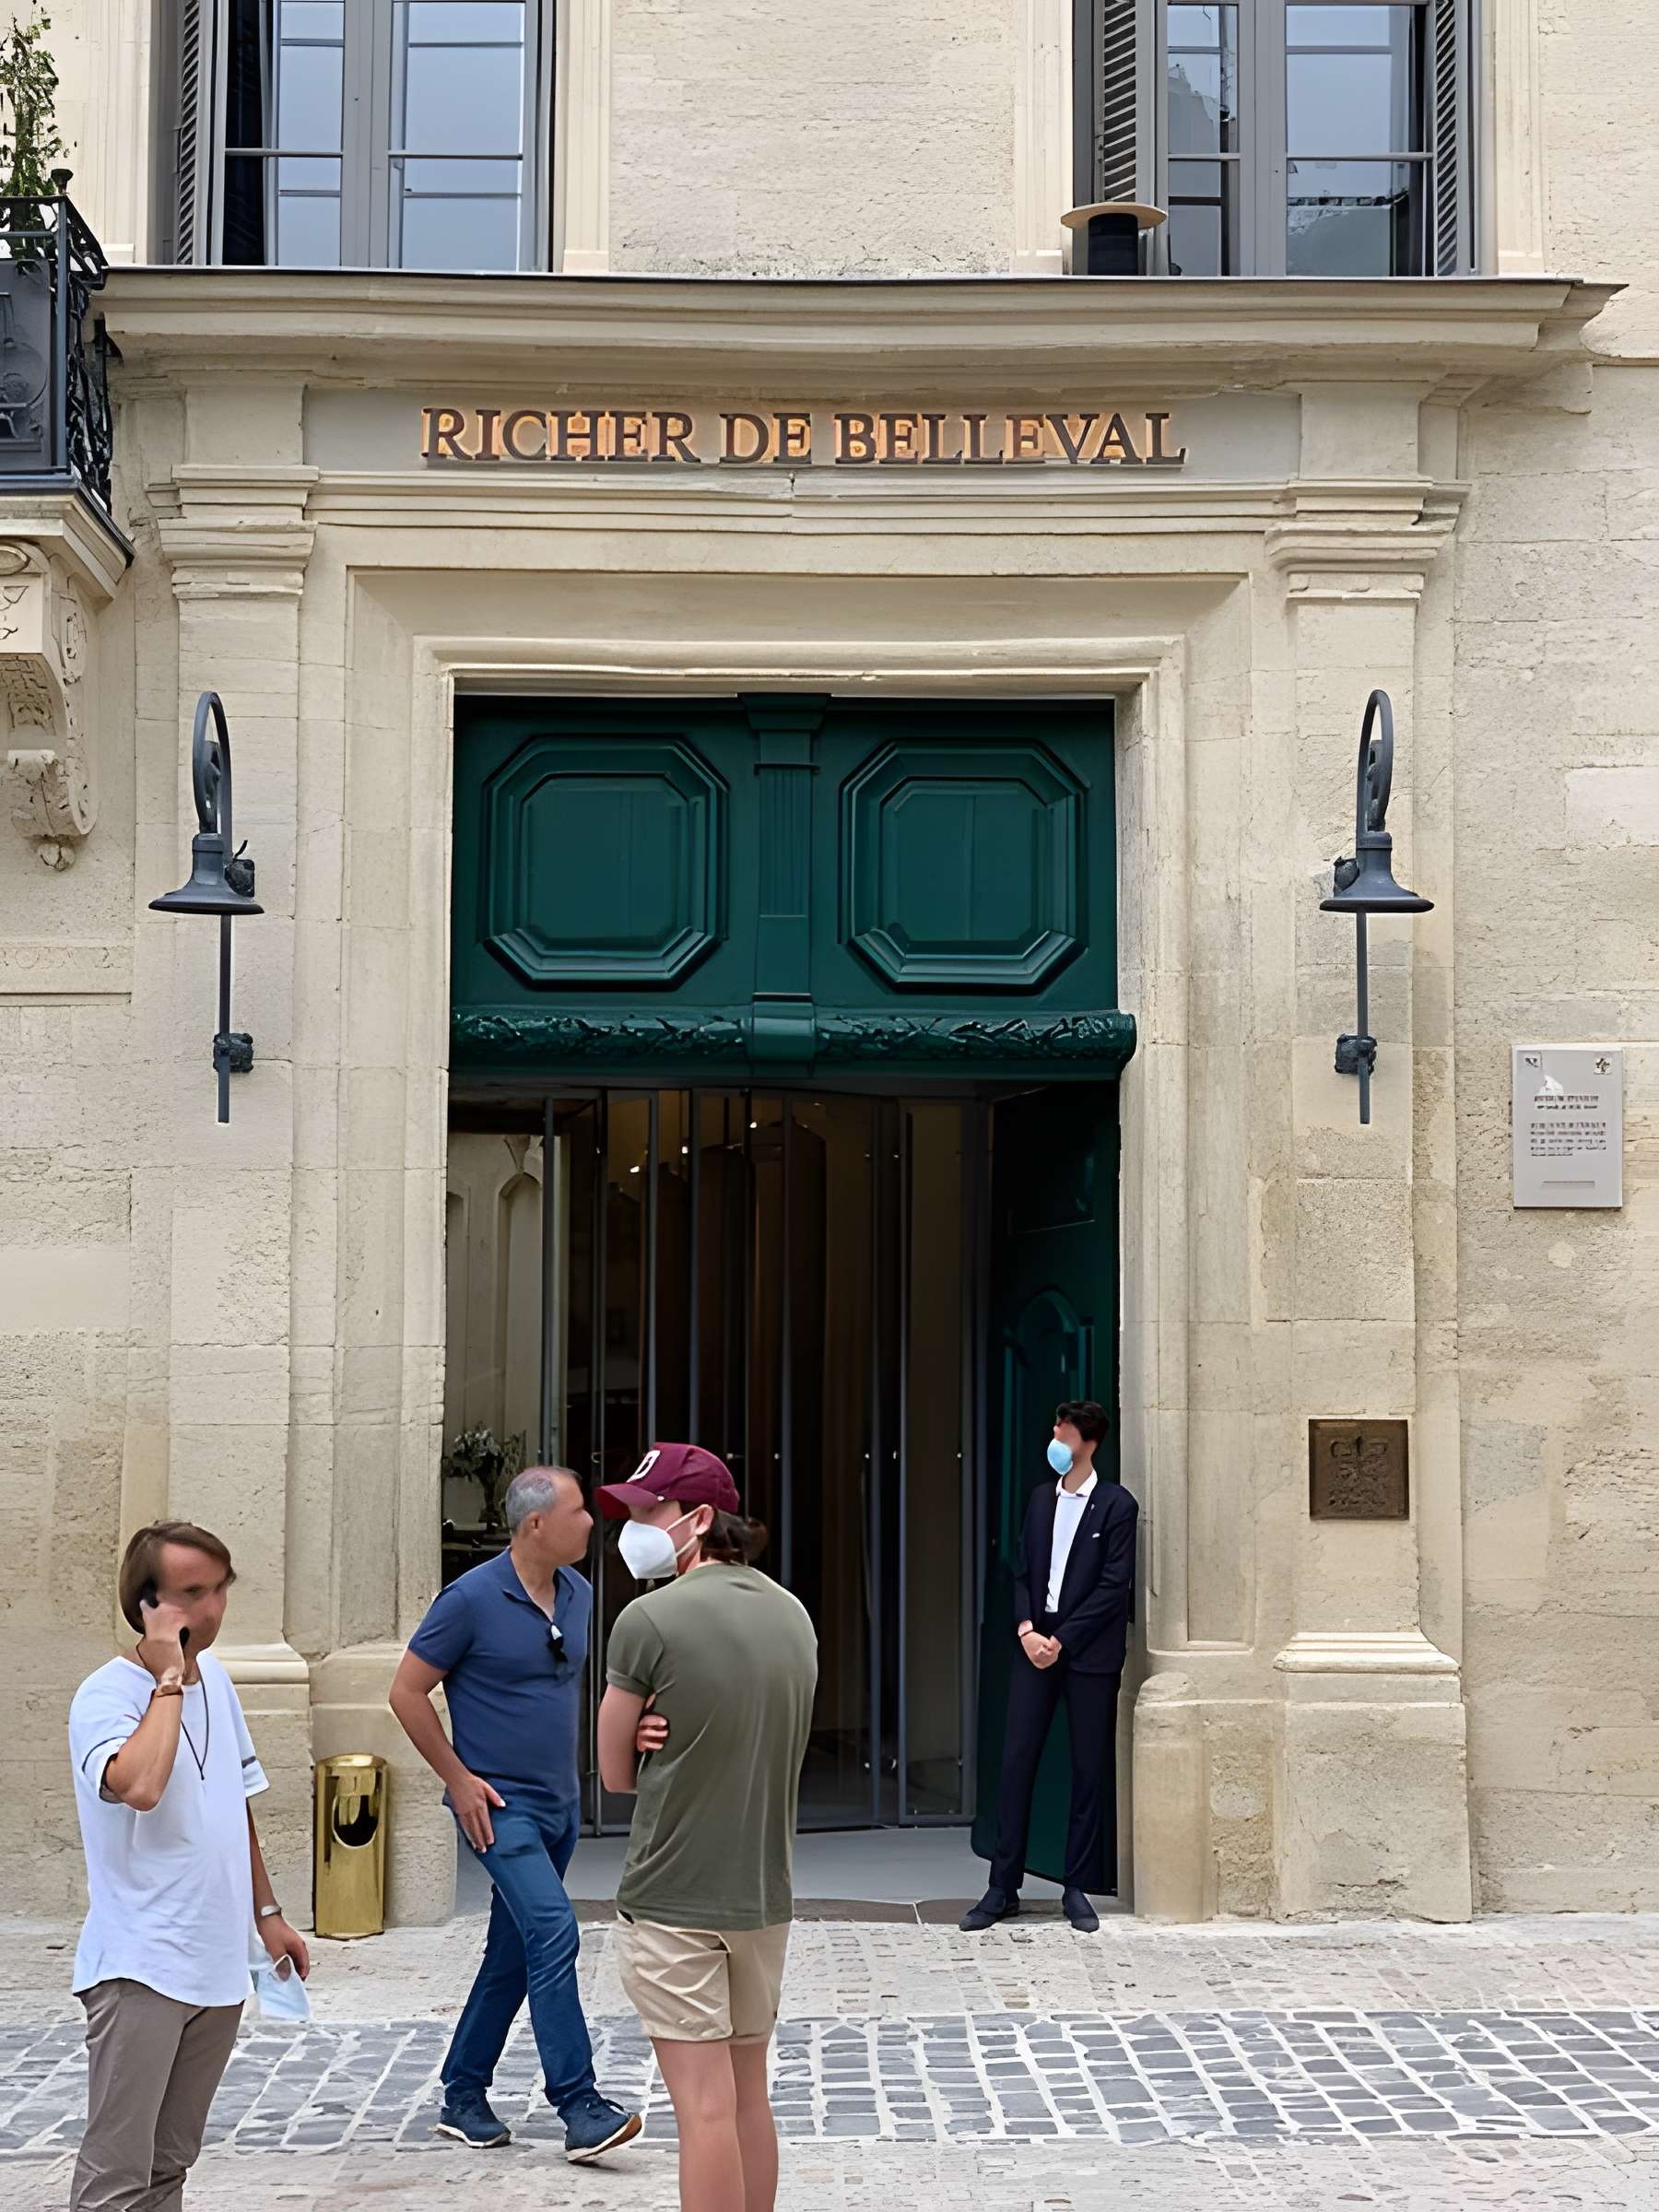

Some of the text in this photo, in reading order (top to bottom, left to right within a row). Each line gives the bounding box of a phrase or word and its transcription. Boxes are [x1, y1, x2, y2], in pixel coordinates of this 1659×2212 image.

[421, 407, 1187, 465] RICHER DE BELLEVAL
